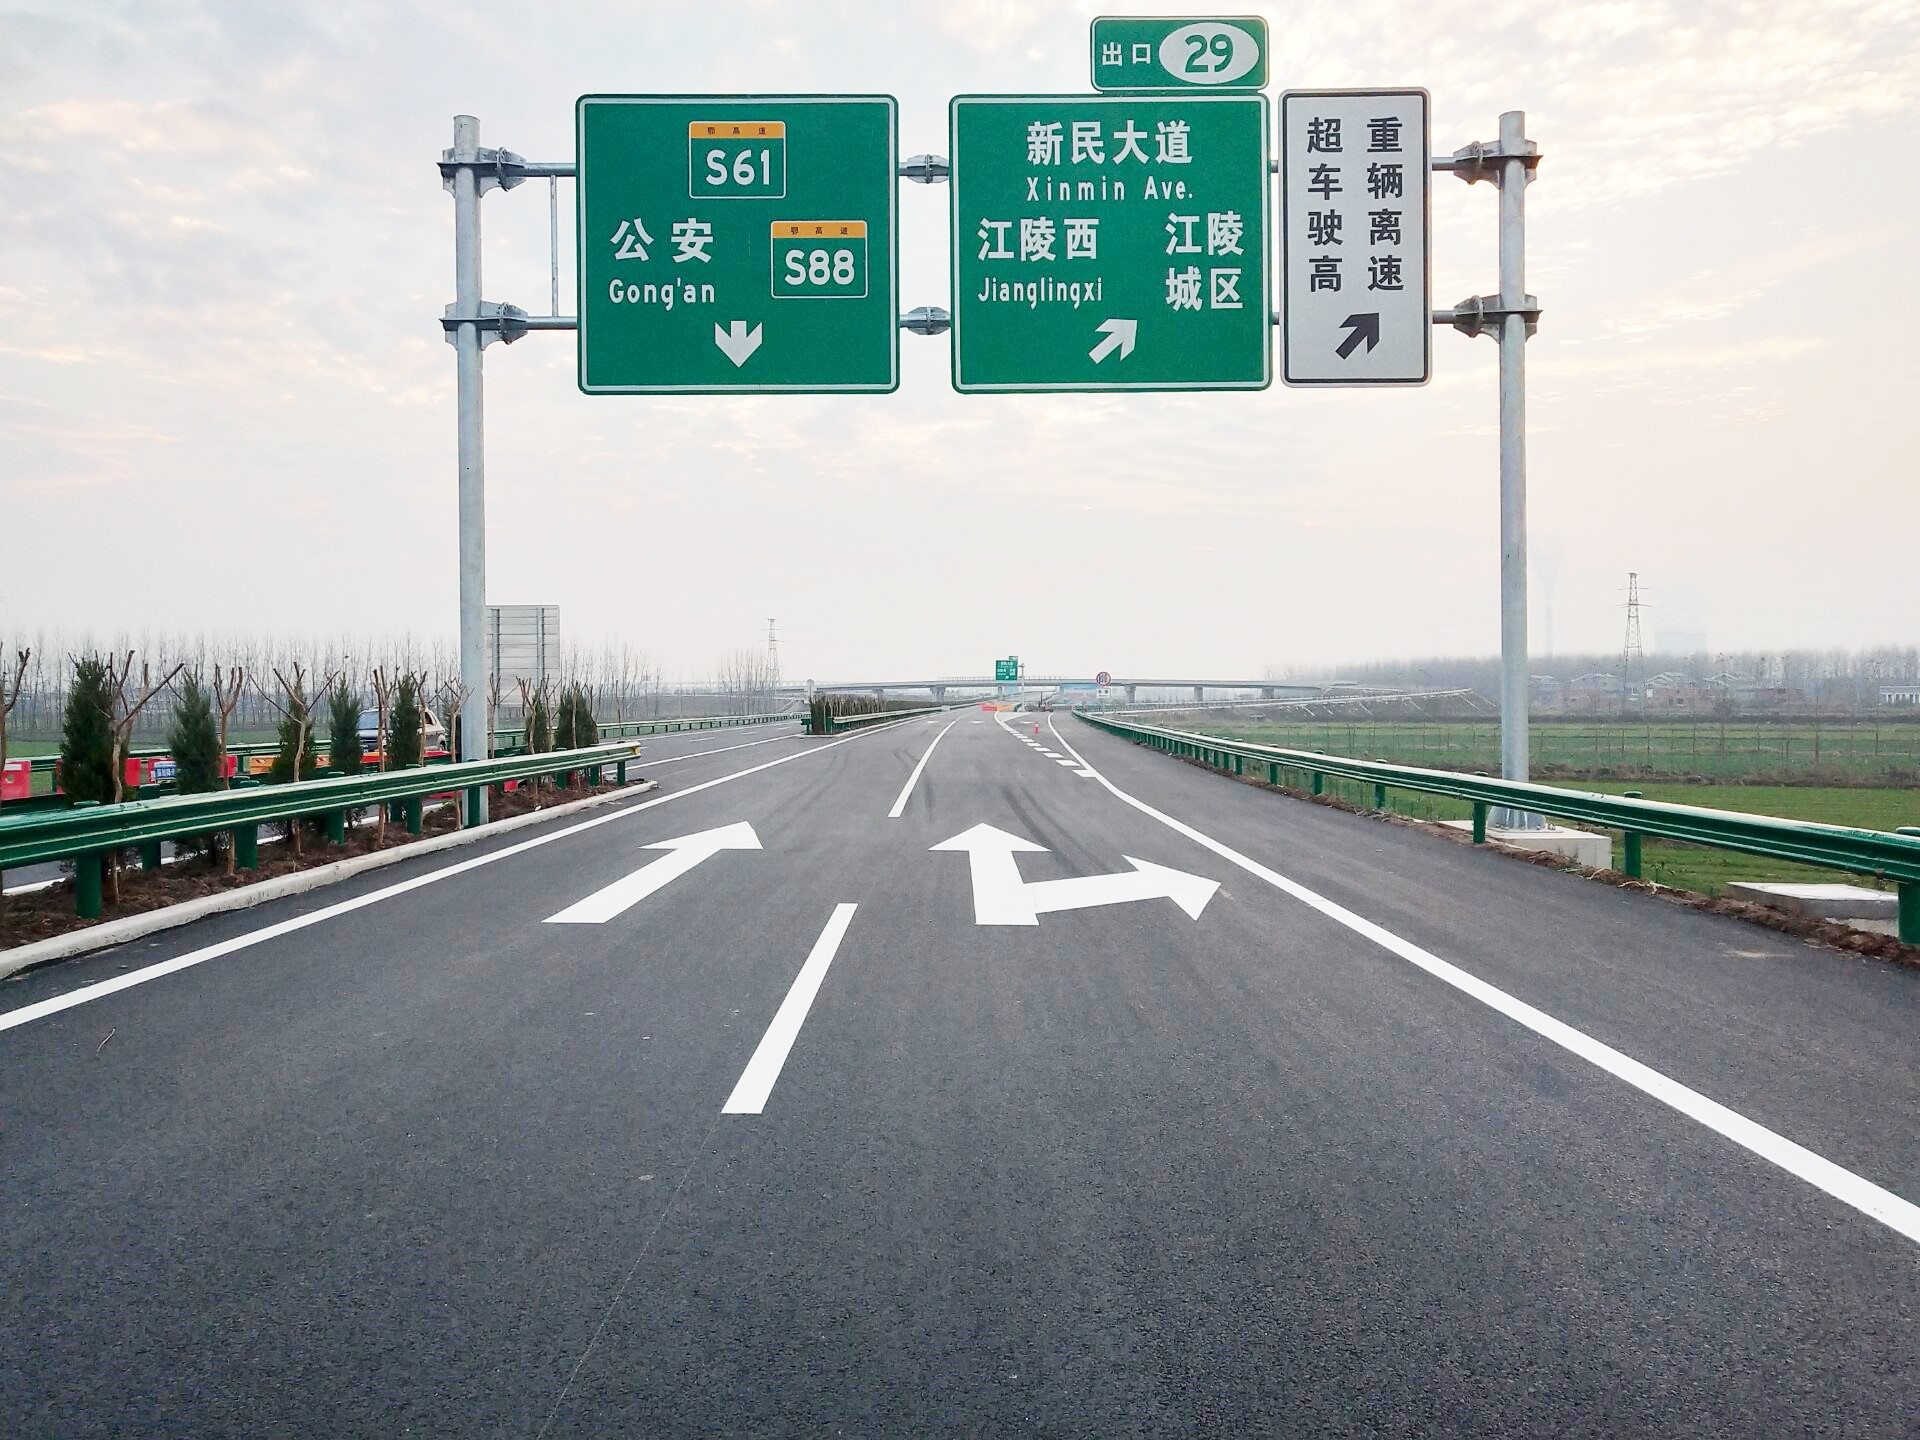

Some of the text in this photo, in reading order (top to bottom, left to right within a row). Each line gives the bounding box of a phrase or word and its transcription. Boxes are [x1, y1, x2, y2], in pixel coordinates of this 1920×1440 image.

[1102, 41, 1151, 66] 出口
[1184, 33, 1234, 73] 29
[1027, 119, 1193, 166] 新民大道
[705, 149, 770, 186] S61
[1026, 175, 1193, 201] Xinmin Ave.
[610, 217, 714, 263] 公安
[977, 216, 1100, 262] 江陵西
[1165, 210, 1244, 257] 江陵
[784, 249, 855, 286] S88
[609, 277, 715, 311] Gong'an
[977, 277, 1102, 310] Jianglingxi
[1165, 265, 1244, 311] 城区
